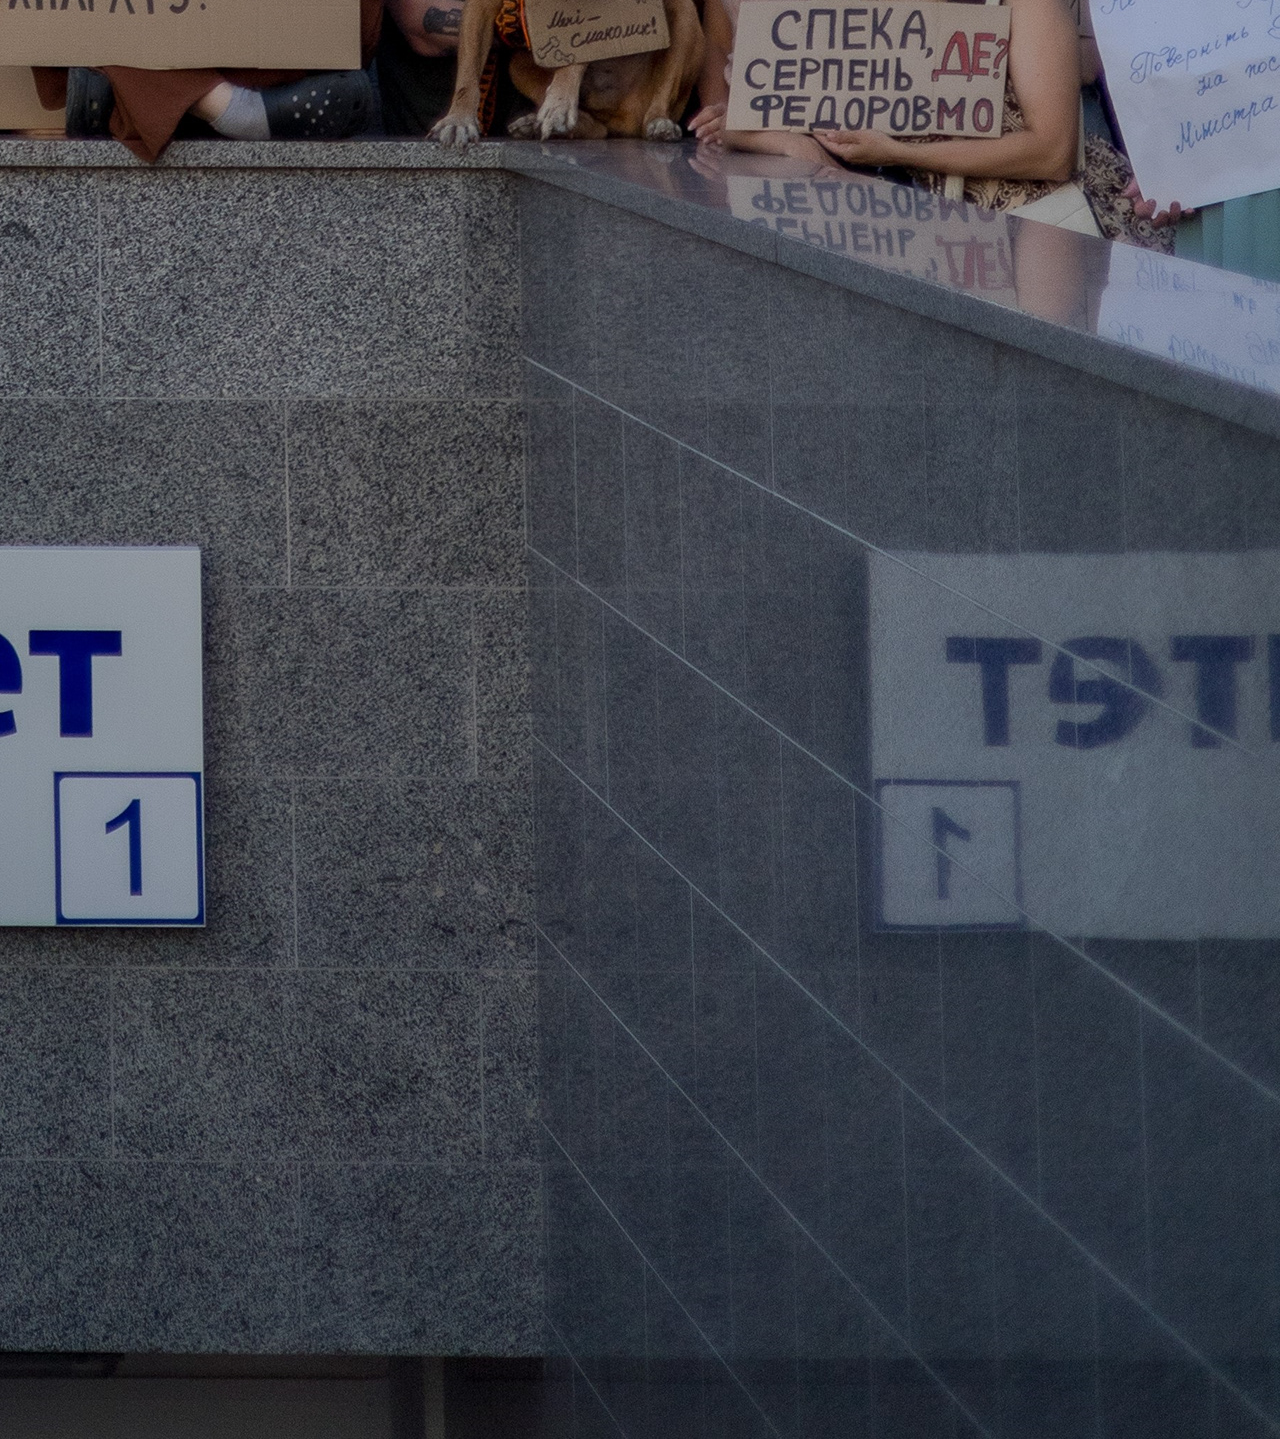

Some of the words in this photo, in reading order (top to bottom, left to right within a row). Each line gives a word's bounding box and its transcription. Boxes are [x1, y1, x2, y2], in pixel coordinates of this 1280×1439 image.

[771, 7, 933, 58] СПЕКА,
[932, 31, 1009, 82] ДЕ?
[1130, 26, 1249, 84] Поверніть
[744, 57, 913, 91] СЕРПЕНЬ
[1196, 72, 1228, 96] на
[1176, 95, 1278, 154] Міністра
[105, 798, 142, 897] 1
